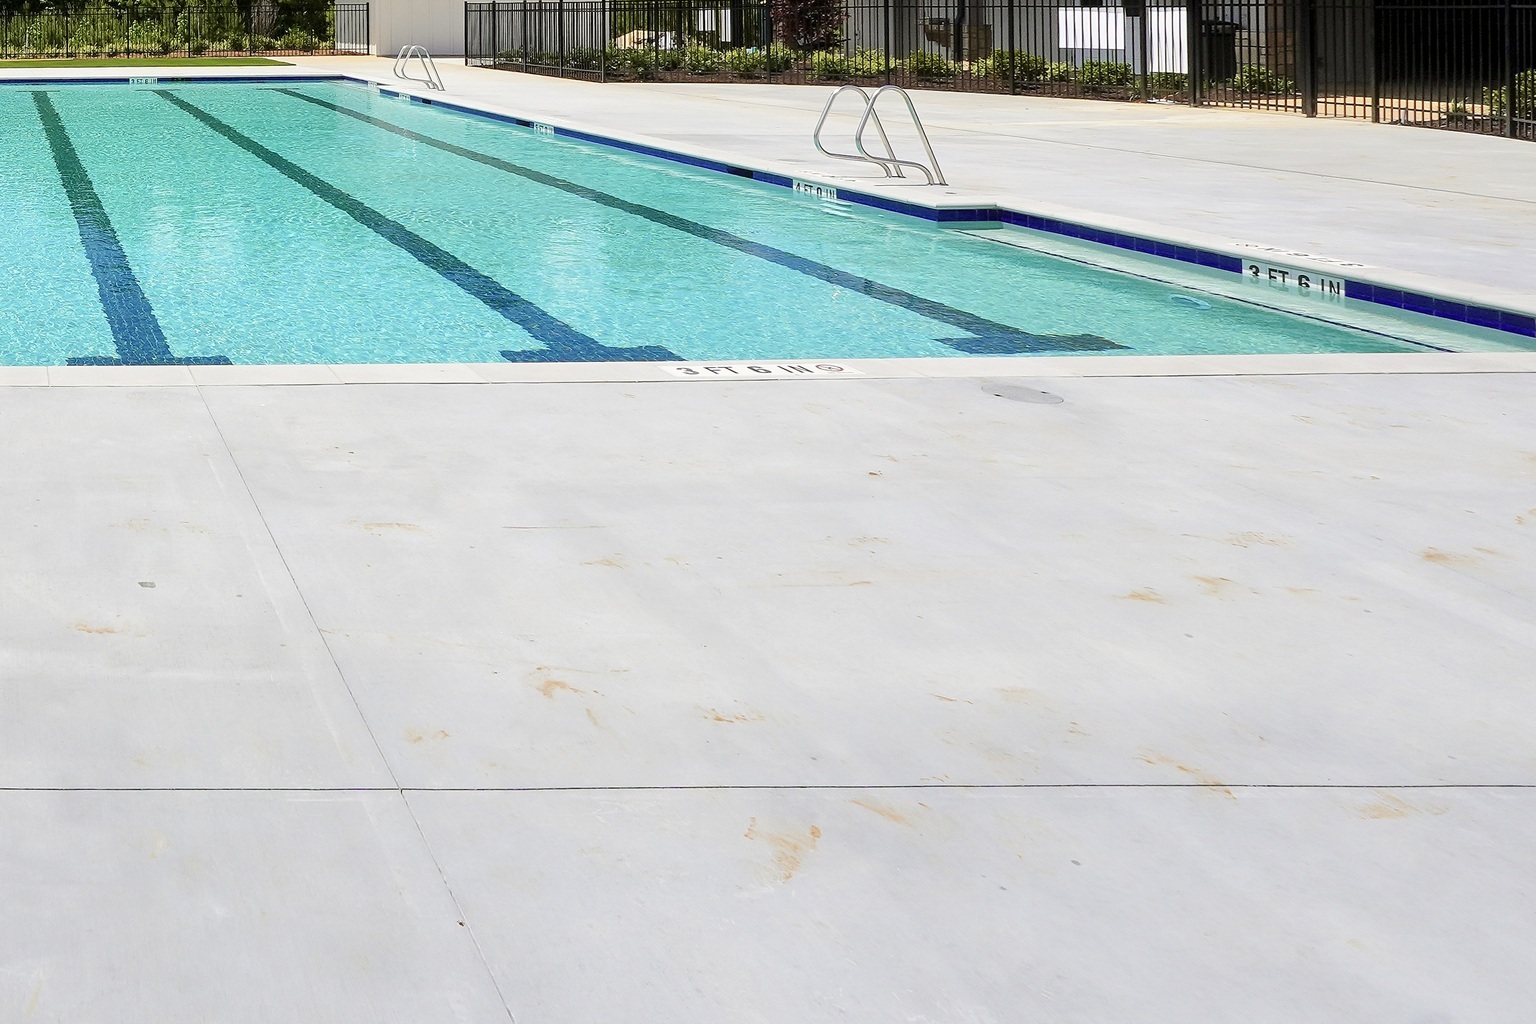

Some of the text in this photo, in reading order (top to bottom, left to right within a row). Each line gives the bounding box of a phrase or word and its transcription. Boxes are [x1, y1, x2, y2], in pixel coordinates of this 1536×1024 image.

[1249, 265, 1340, 295] 3 FT 6 IN
[676, 364, 815, 376] 3 FT 6 IN
